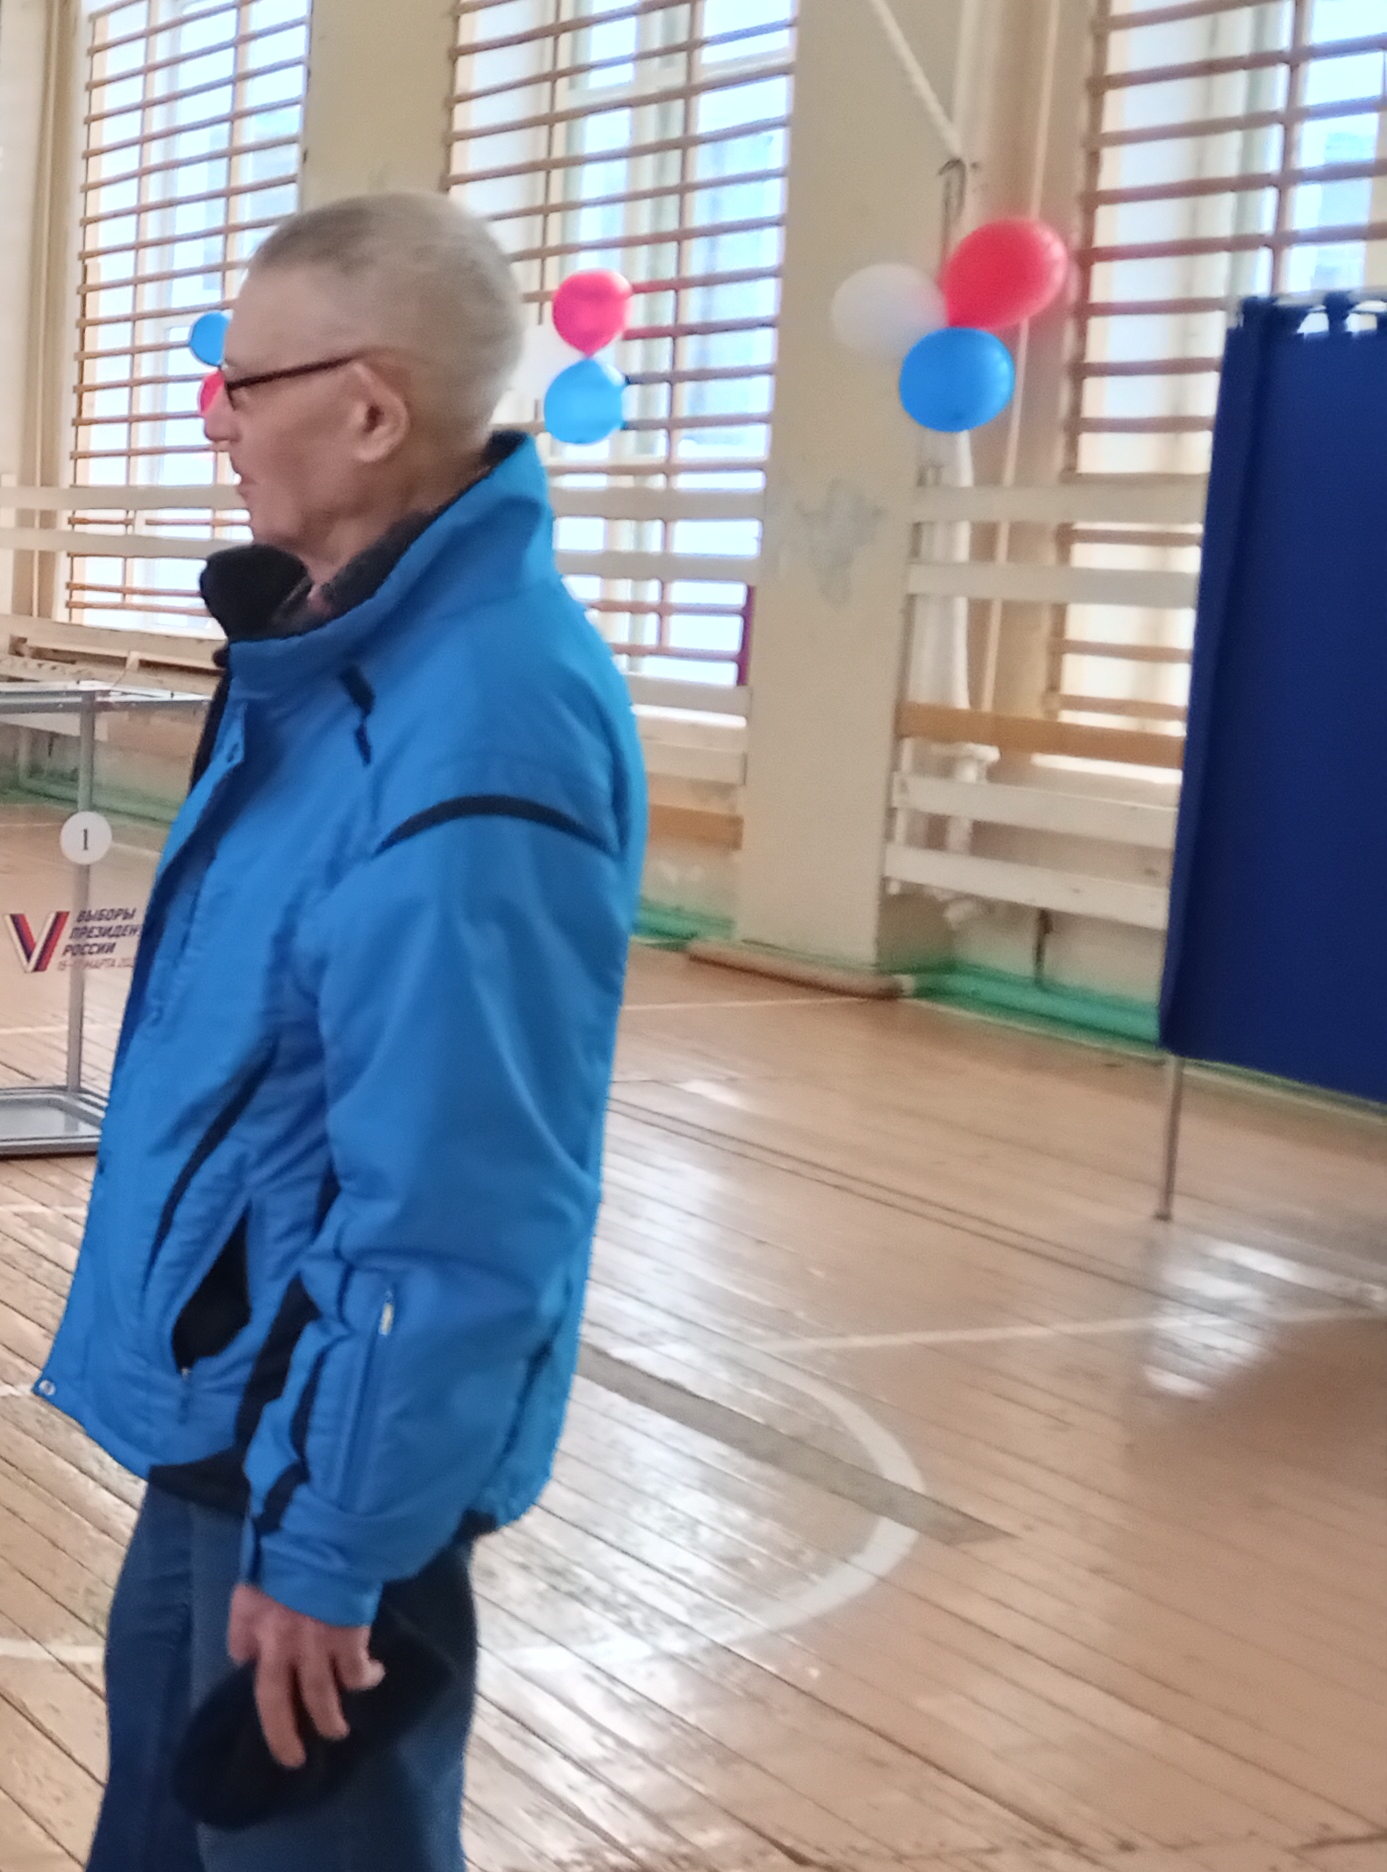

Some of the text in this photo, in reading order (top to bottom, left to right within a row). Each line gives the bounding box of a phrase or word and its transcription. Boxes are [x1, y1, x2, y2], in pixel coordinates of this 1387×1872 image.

[83, 828, 89, 851] 1
[76, 907, 137, 923] ВЫБОРЫ
[68, 924, 142, 940] ПРЕЗИДЕН
[62, 942, 116, 956] РОССИИ
